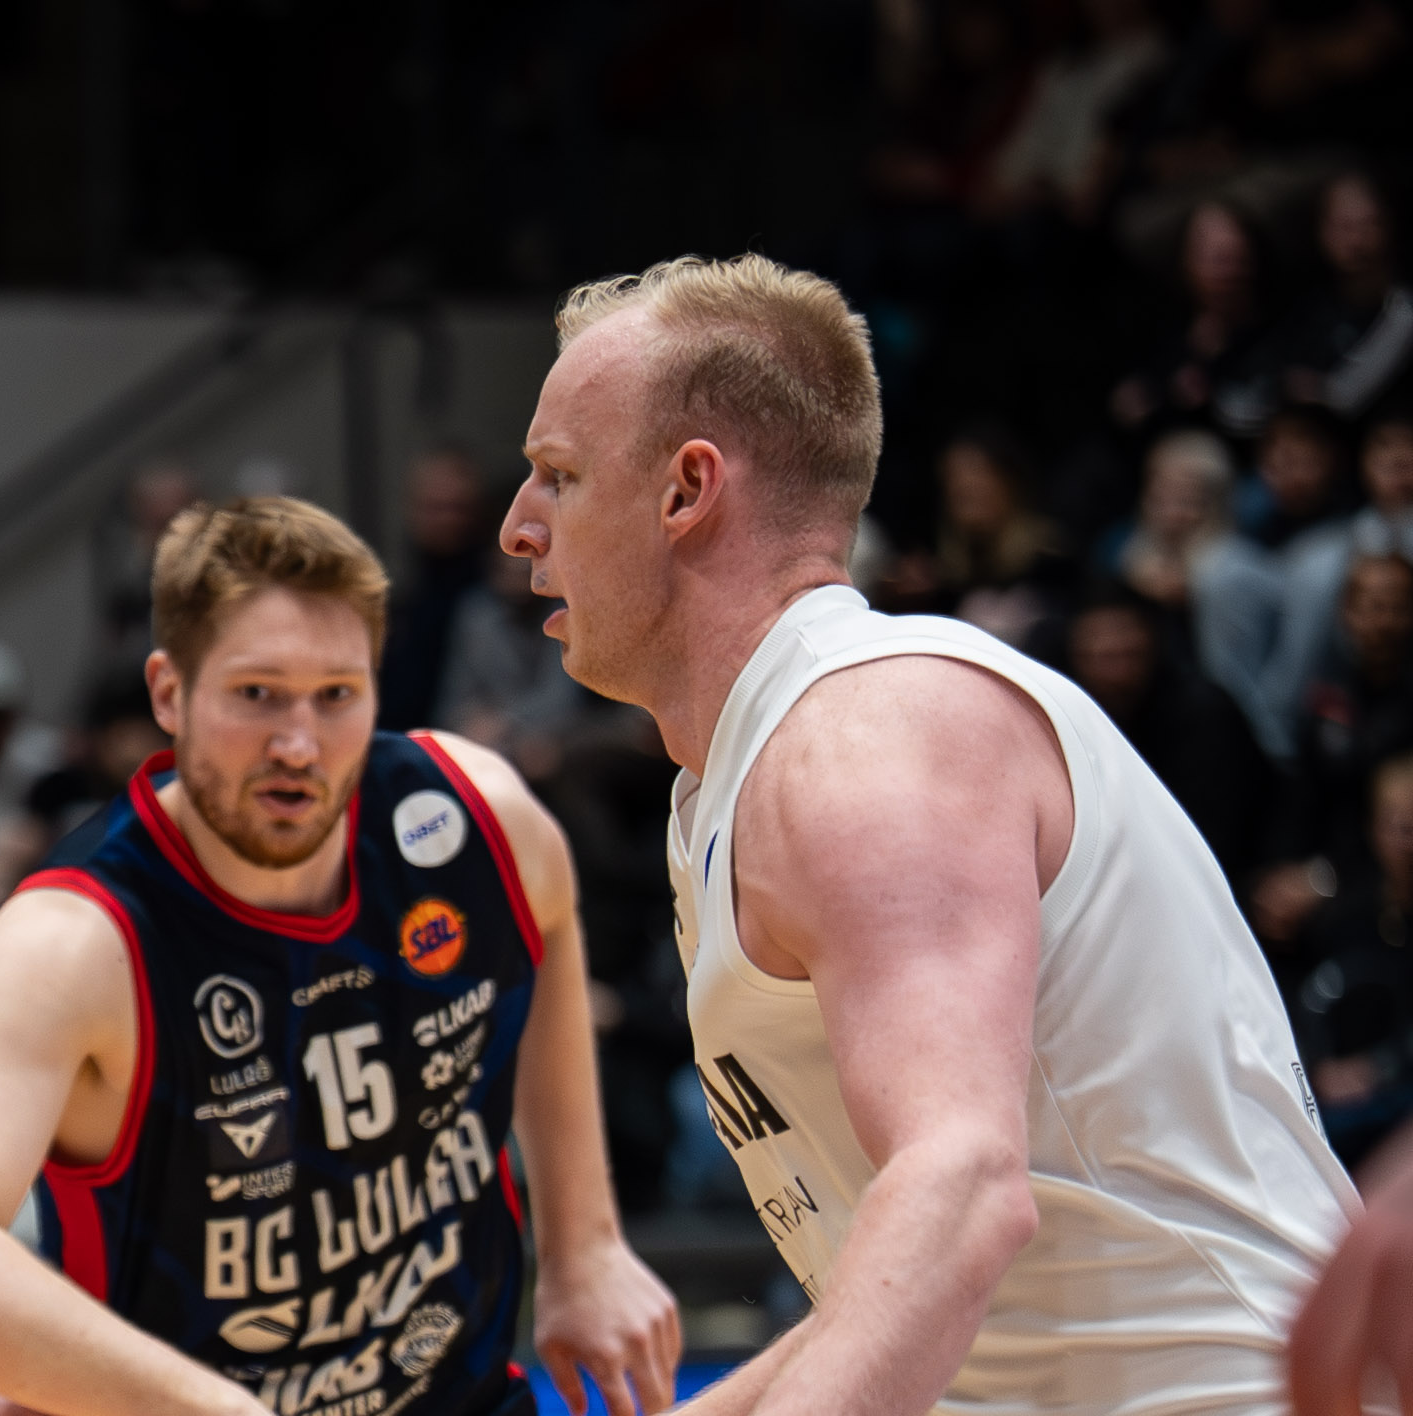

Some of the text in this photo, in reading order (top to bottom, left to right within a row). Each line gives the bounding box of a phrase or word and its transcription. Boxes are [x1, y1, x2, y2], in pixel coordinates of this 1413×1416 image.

[410, 914, 459, 961] SBL
[302, 1021, 397, 1150] 15
[203, 1205, 301, 1299] BC
